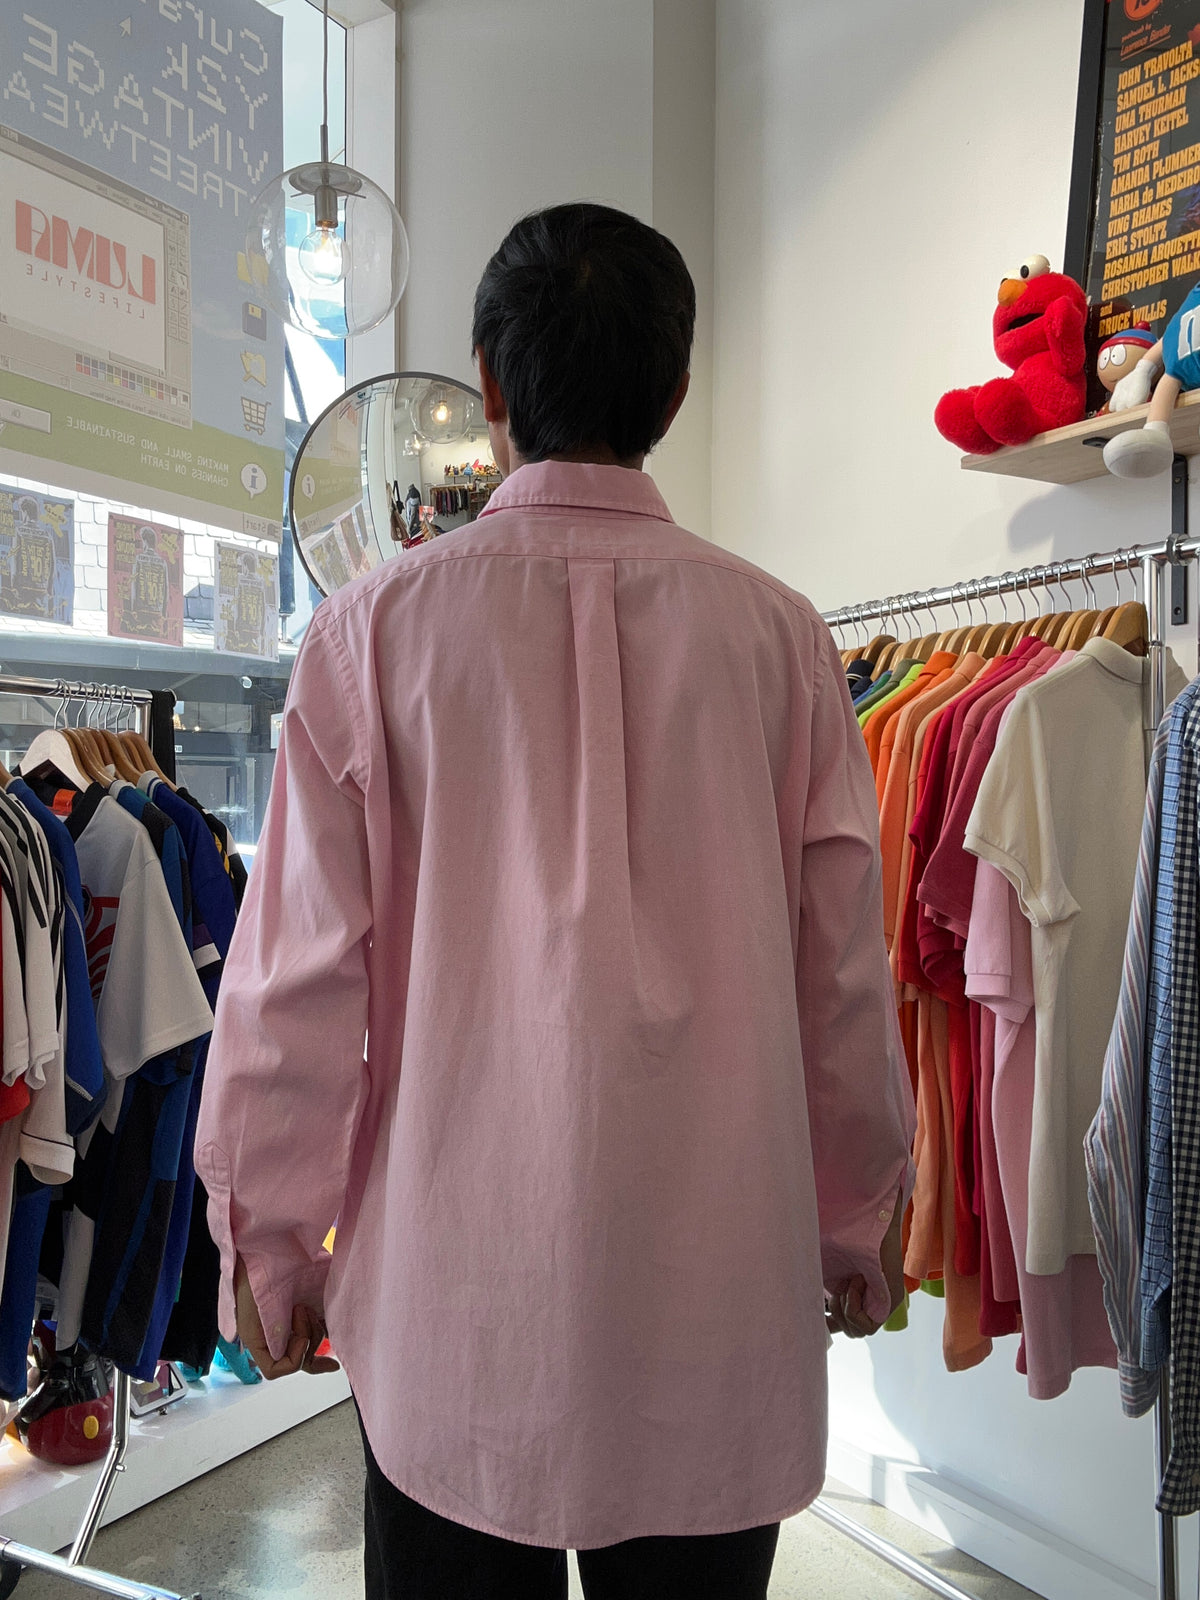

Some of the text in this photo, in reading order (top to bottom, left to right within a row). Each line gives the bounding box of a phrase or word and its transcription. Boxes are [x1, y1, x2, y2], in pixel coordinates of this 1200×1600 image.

[1117, 64, 1142, 92] JOHN
[1143, 40, 1193, 79] TRAVOLTA
[1115, 85, 1187, 134] UMA THURMAN
[1116, 80, 1155, 113] SAMUEL
[1113, 106, 1189, 156] HARVEY KEITEL
[1113, 139, 1160, 176] TIM ROTH
[1110, 164, 1150, 197] AMANDA
[1107, 197, 1173, 238] VING RHAMES
[1109, 190, 1139, 218] MARIA
[1142, 186, 1154, 206] de
[1105, 220, 1167, 260] ERIC STOLTZ
[1101, 262, 1169, 301] CHRISTOPHER
[1103, 248, 1148, 281] ROSANNA
[1098, 299, 1167, 338] BRUCE WILLIS
[1100, 301, 1112, 317] and
